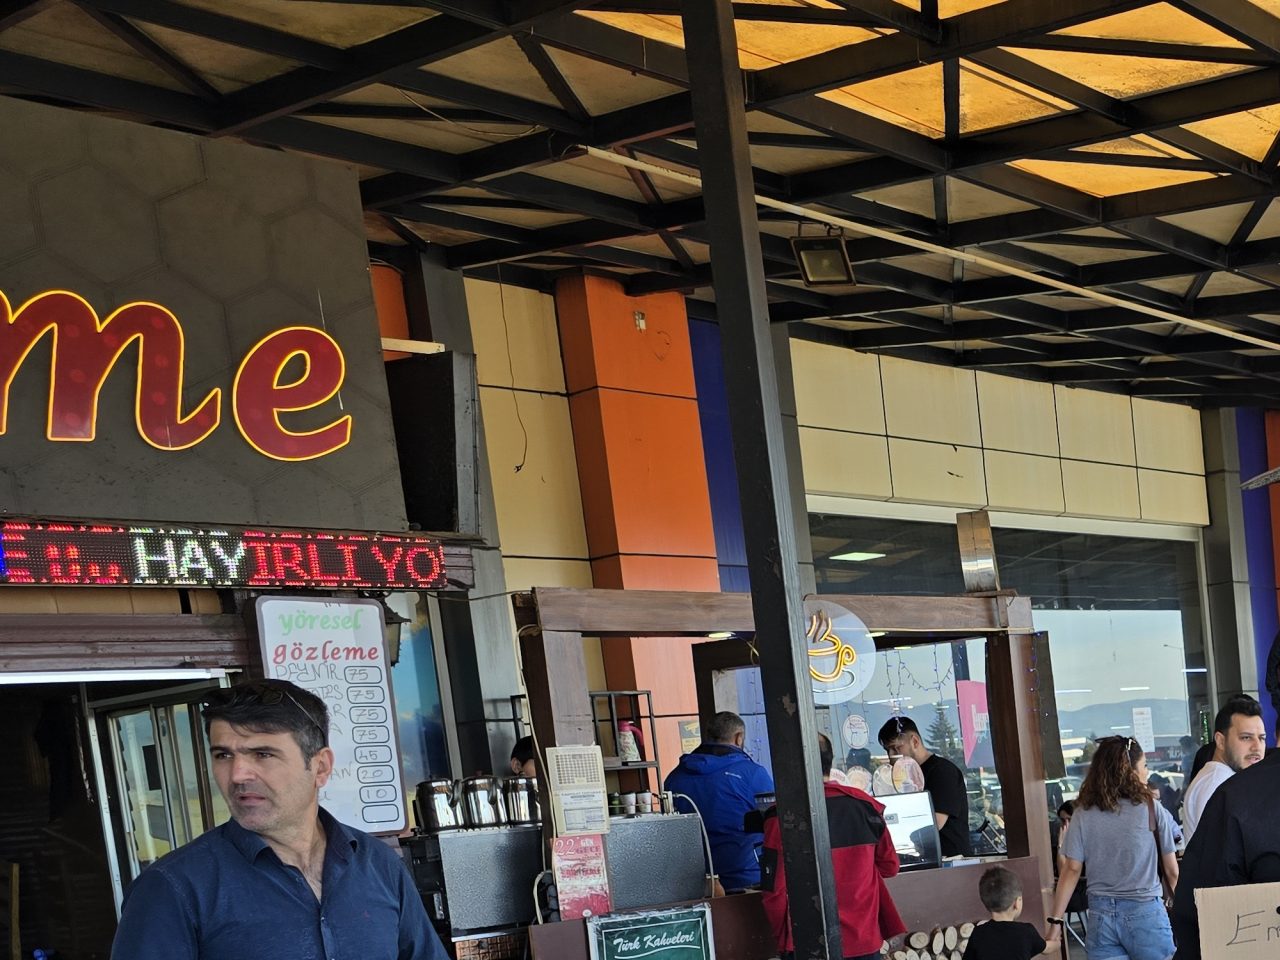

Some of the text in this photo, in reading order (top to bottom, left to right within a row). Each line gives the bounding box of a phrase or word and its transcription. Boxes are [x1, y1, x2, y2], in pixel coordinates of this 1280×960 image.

[134, 537, 361, 580] HAYIRLI
[371, 545, 446, 582] YO
[278, 608, 364, 636] yöresel
[273, 640, 379, 665] gözleme
[347, 669, 369, 681] 75
[350, 690, 375, 701] 75
[354, 709, 379, 720] 75
[356, 730, 378, 740] 75
[361, 770, 384, 780] 20
[367, 789, 387, 799] 10
[556, 838, 575, 856] 22
[613, 931, 694, 953] Türk Kahveleri
